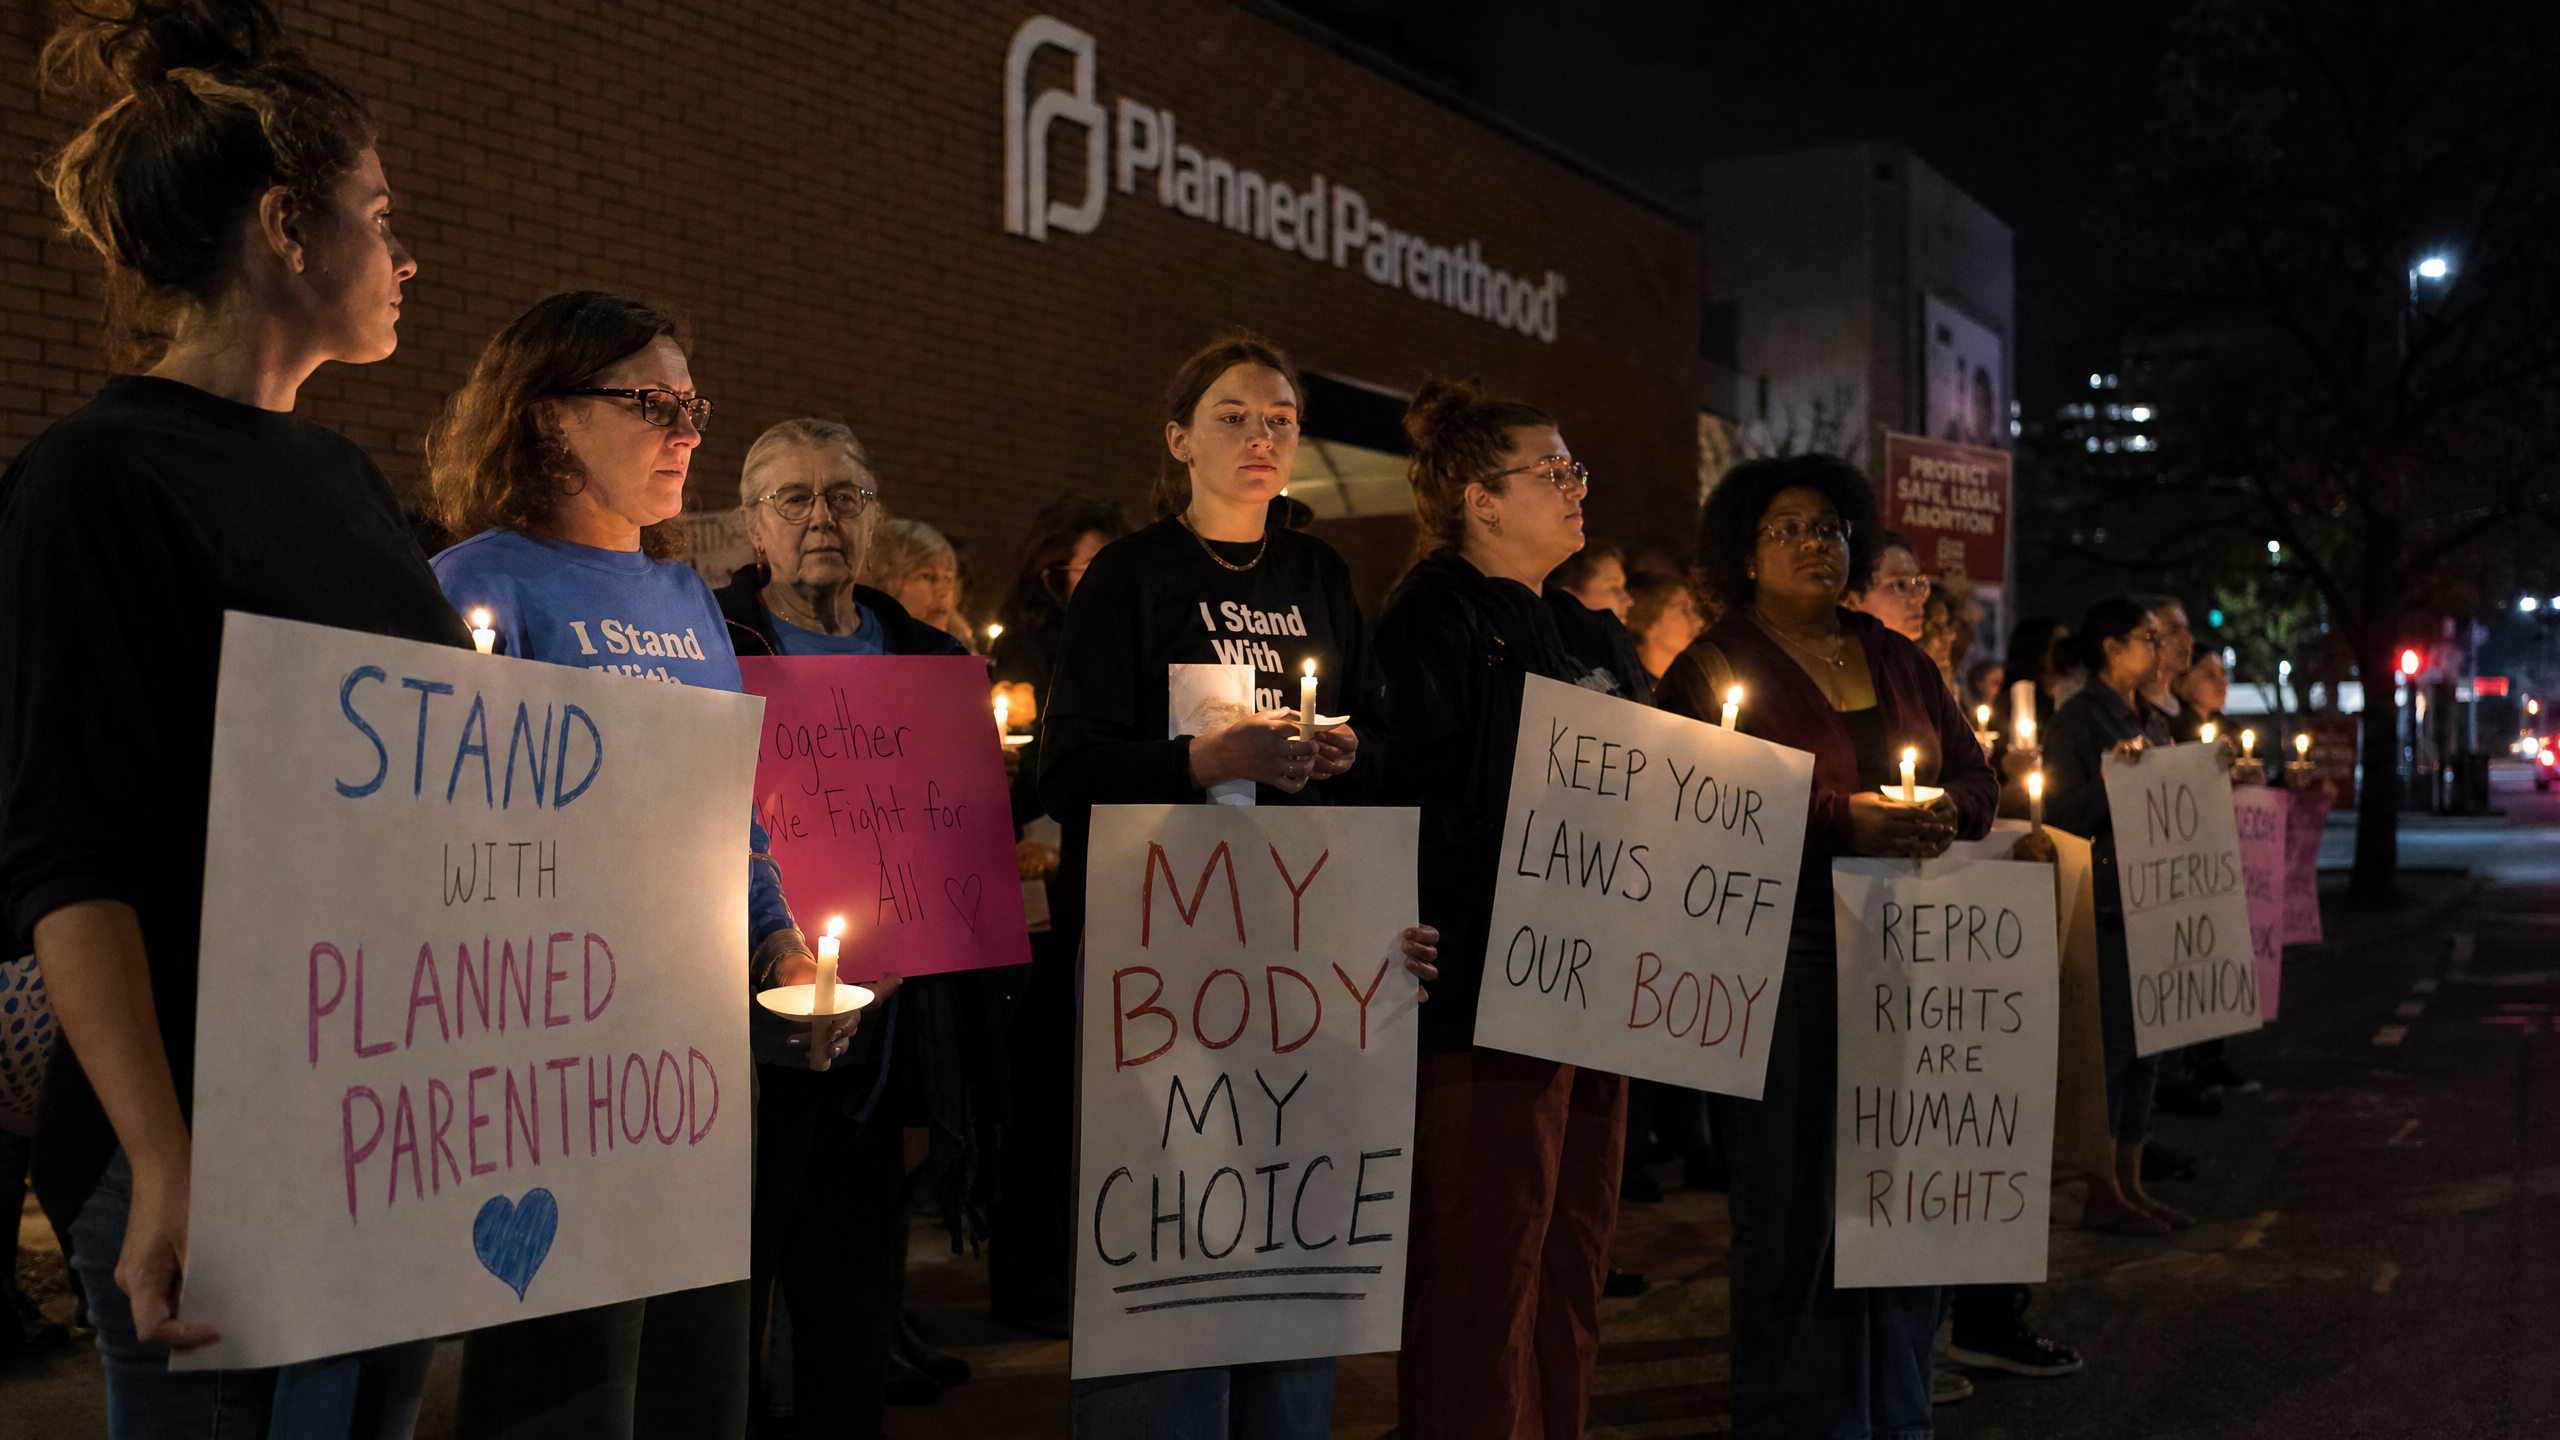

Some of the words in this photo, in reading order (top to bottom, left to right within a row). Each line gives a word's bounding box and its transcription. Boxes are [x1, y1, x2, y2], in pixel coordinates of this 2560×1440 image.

[1117, 97, 1327, 261] Planned
[1897, 478, 1947, 505] SAFE,
[1951, 488, 2001, 513] LEGAL
[1910, 456, 1988, 486] PROTECT
[1903, 505, 1994, 535] ABORTION
[570, 621, 598, 655] I
[601, 619, 705, 661] Stand
[1199, 602, 1217, 631] I
[1220, 601, 1308, 637] Stand
[1211, 639, 1284, 674] With
[335, 665, 602, 810] STAND
[759, 687, 911, 796] ogether
[1547, 717, 1647, 802] KEEP
[1667, 758, 1764, 845] YOUR
[2145, 781, 2199, 847] NO
[757, 794, 809, 843] We
[824, 784, 905, 865] Fight
[924, 780, 967, 831] for
[443, 841, 557, 907] WITH
[877, 860, 924, 926] All
[1141, 840, 1329, 952] MY
[1517, 809, 1652, 902] LAWS
[1684, 864, 1782, 936] OFF
[2127, 850, 2236, 908] UTERUS
[1882, 901, 2022, 964] REPRO
[2172, 912, 2215, 963] NO
[308, 932, 617, 1068] PLANNED
[1112, 958, 1390, 1073] BODY
[1506, 925, 1592, 1010] OUR
[1627, 952, 1768, 1059] BODY
[1875, 983, 2023, 1034] RIGHTS
[2136, 957, 2256, 1029] OPINION
[1916, 1044, 1983, 1075] ARE
[342, 1046, 720, 1224] PARENTHOOD
[1162, 1070, 1308, 1150] MY
[1855, 1085, 2019, 1149] HUMAN
[1094, 1147, 1403, 1267] CHOICE
[1867, 1168, 2028, 1228] RIGHTS
